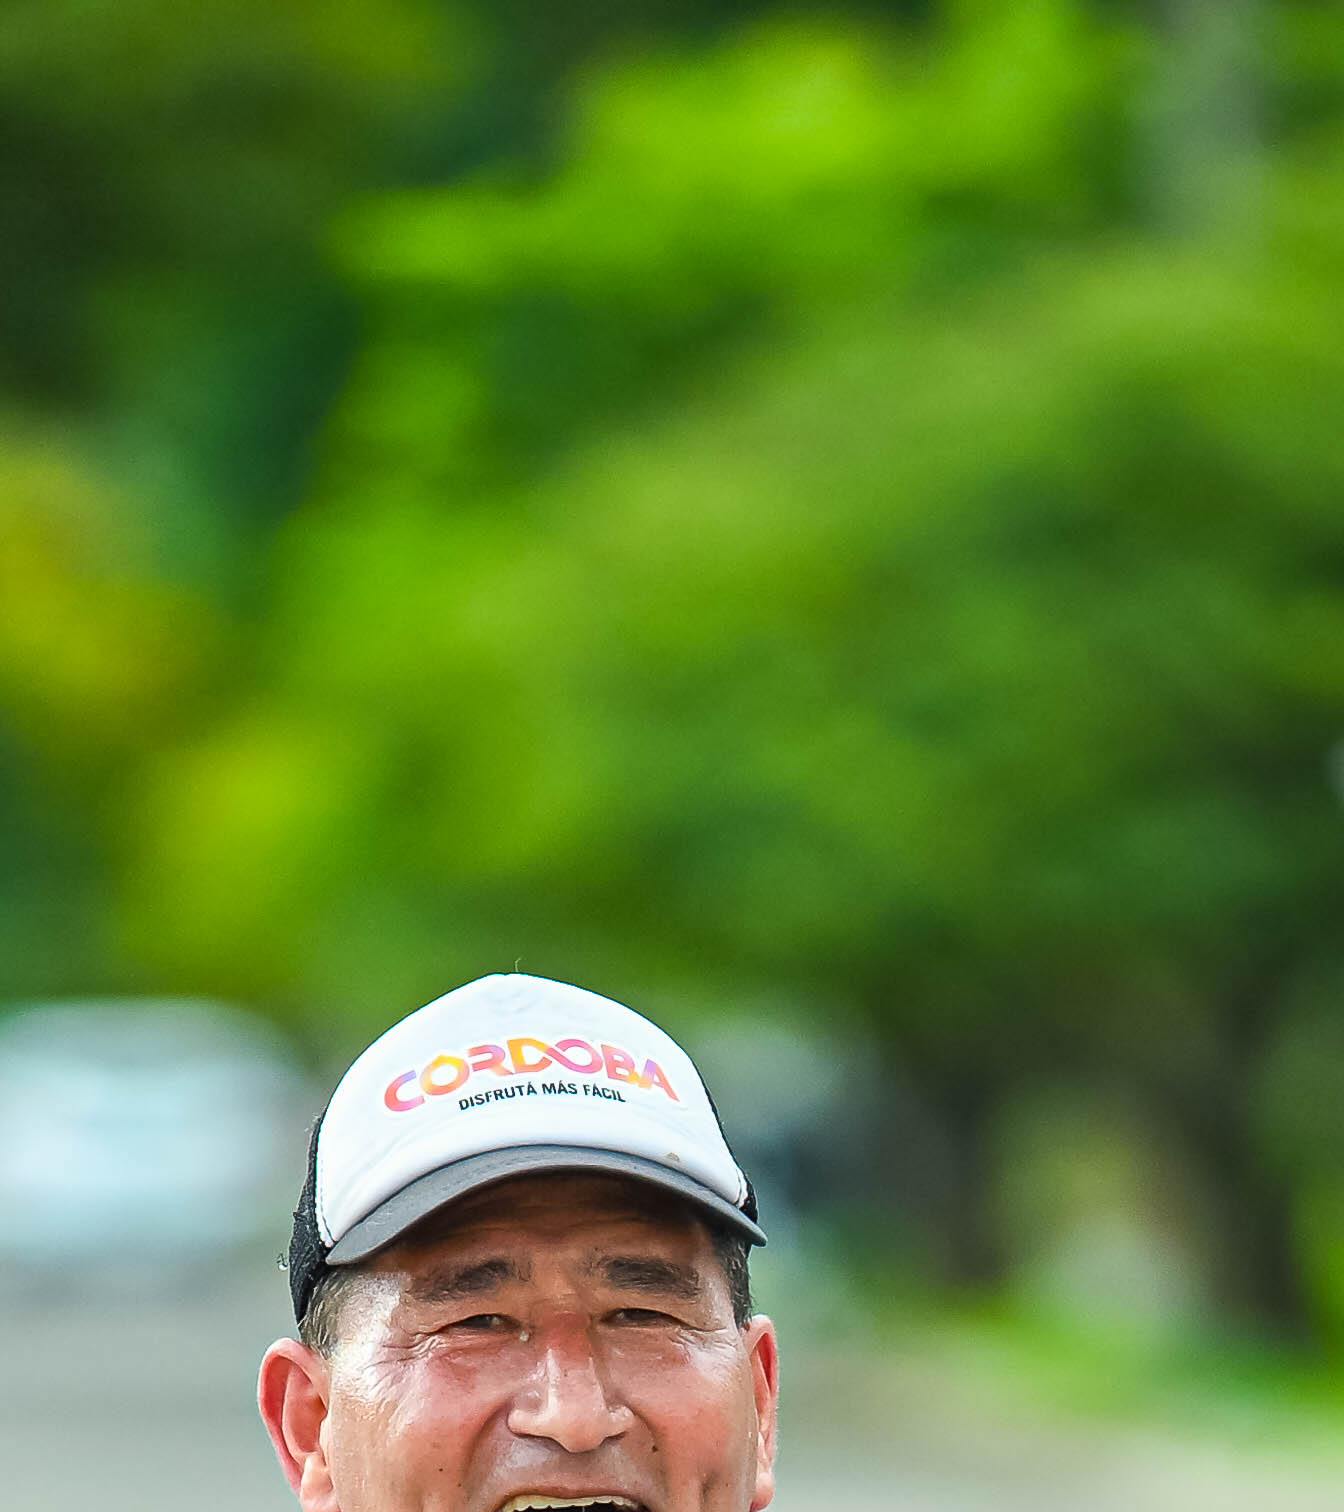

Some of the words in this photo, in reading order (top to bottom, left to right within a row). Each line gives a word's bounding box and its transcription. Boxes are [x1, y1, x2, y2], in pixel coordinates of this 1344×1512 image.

[383, 1037, 681, 1113] CORDOBA
[458, 1080, 537, 1112] DISFRUTÁ
[541, 1080, 578, 1096] MÁS
[583, 1083, 627, 1104] FÁCIL
